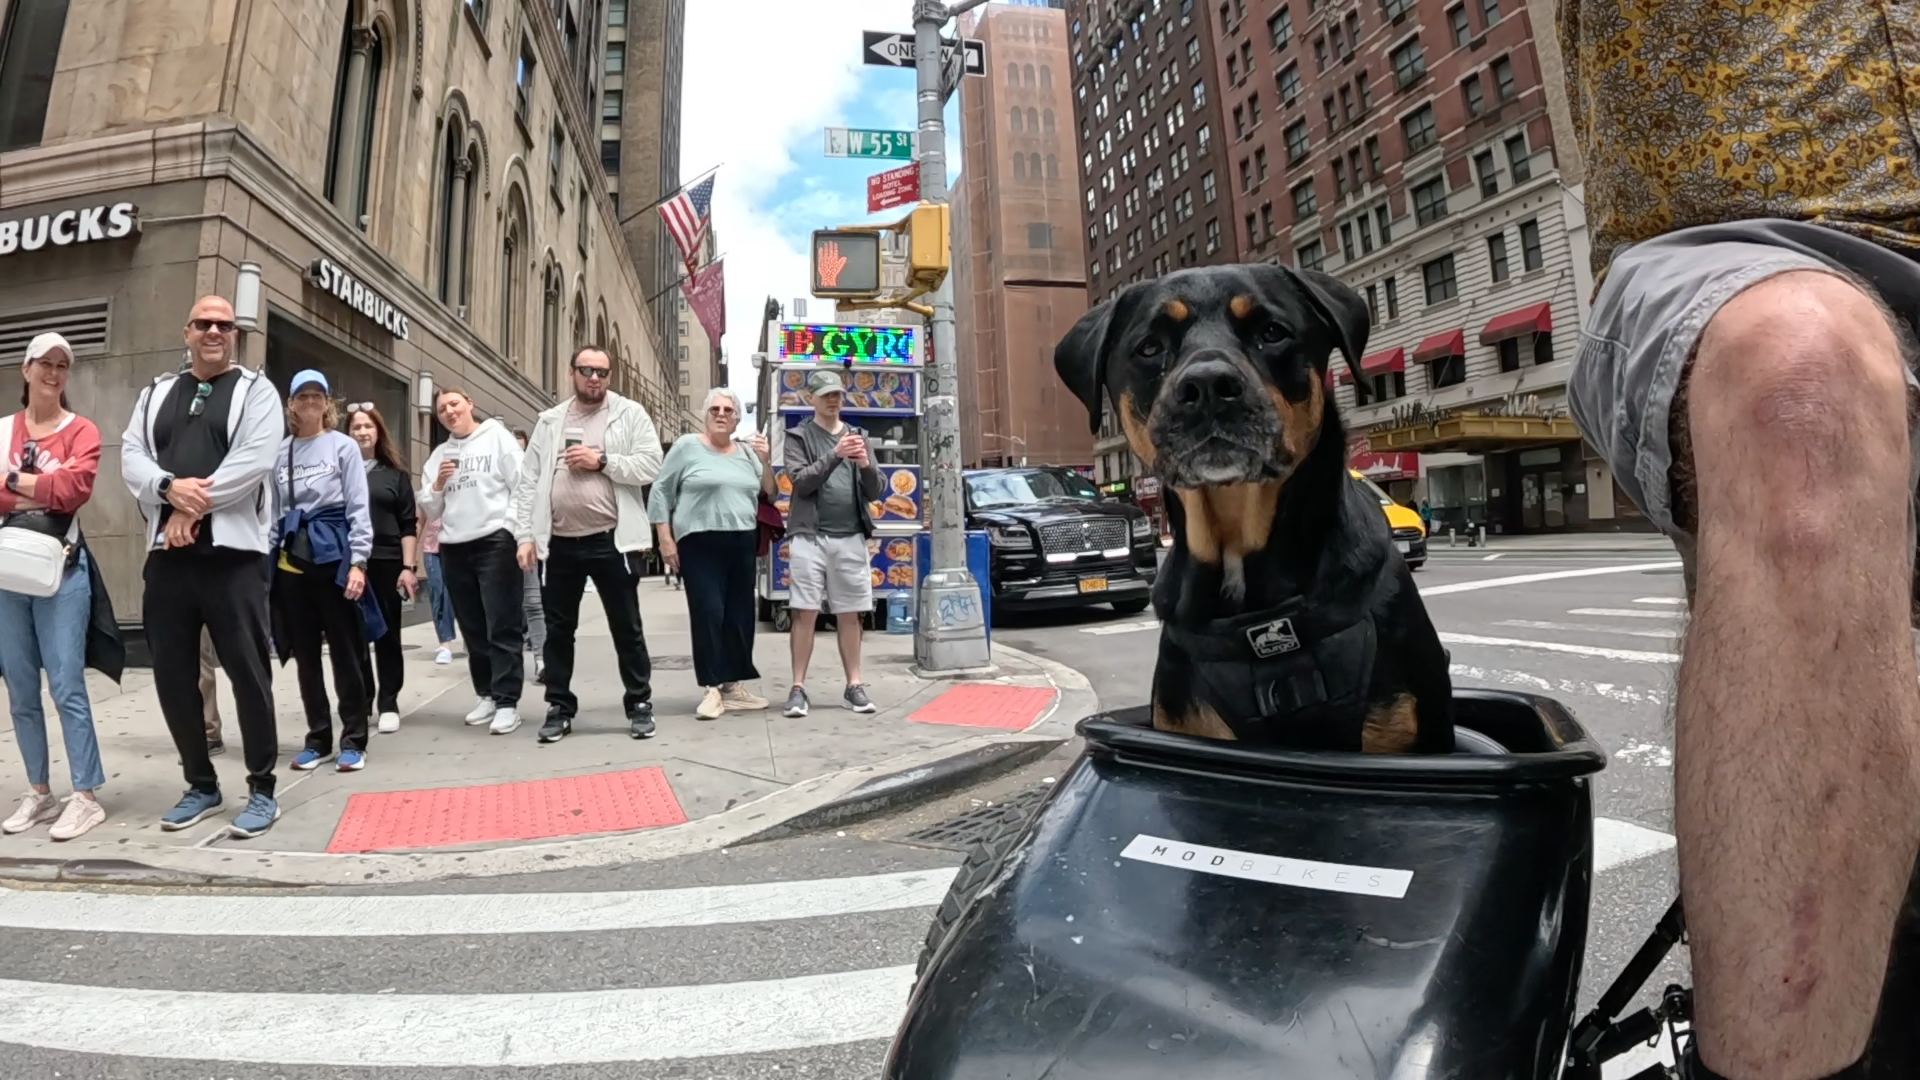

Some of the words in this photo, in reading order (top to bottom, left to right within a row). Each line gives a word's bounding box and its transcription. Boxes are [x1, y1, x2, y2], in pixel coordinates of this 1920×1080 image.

[849, 131, 864, 154] W
[871, 132, 892, 156] 55
[896, 132, 908, 147] St
[870, 176, 881, 186] NO
[882, 167, 915, 183] STANDING
[882, 180, 903, 190] HOTEL
[872, 188, 896, 201] LOADING
[897, 184, 914, 194] ZONE
[319, 257, 410, 341] STARBUCKS
